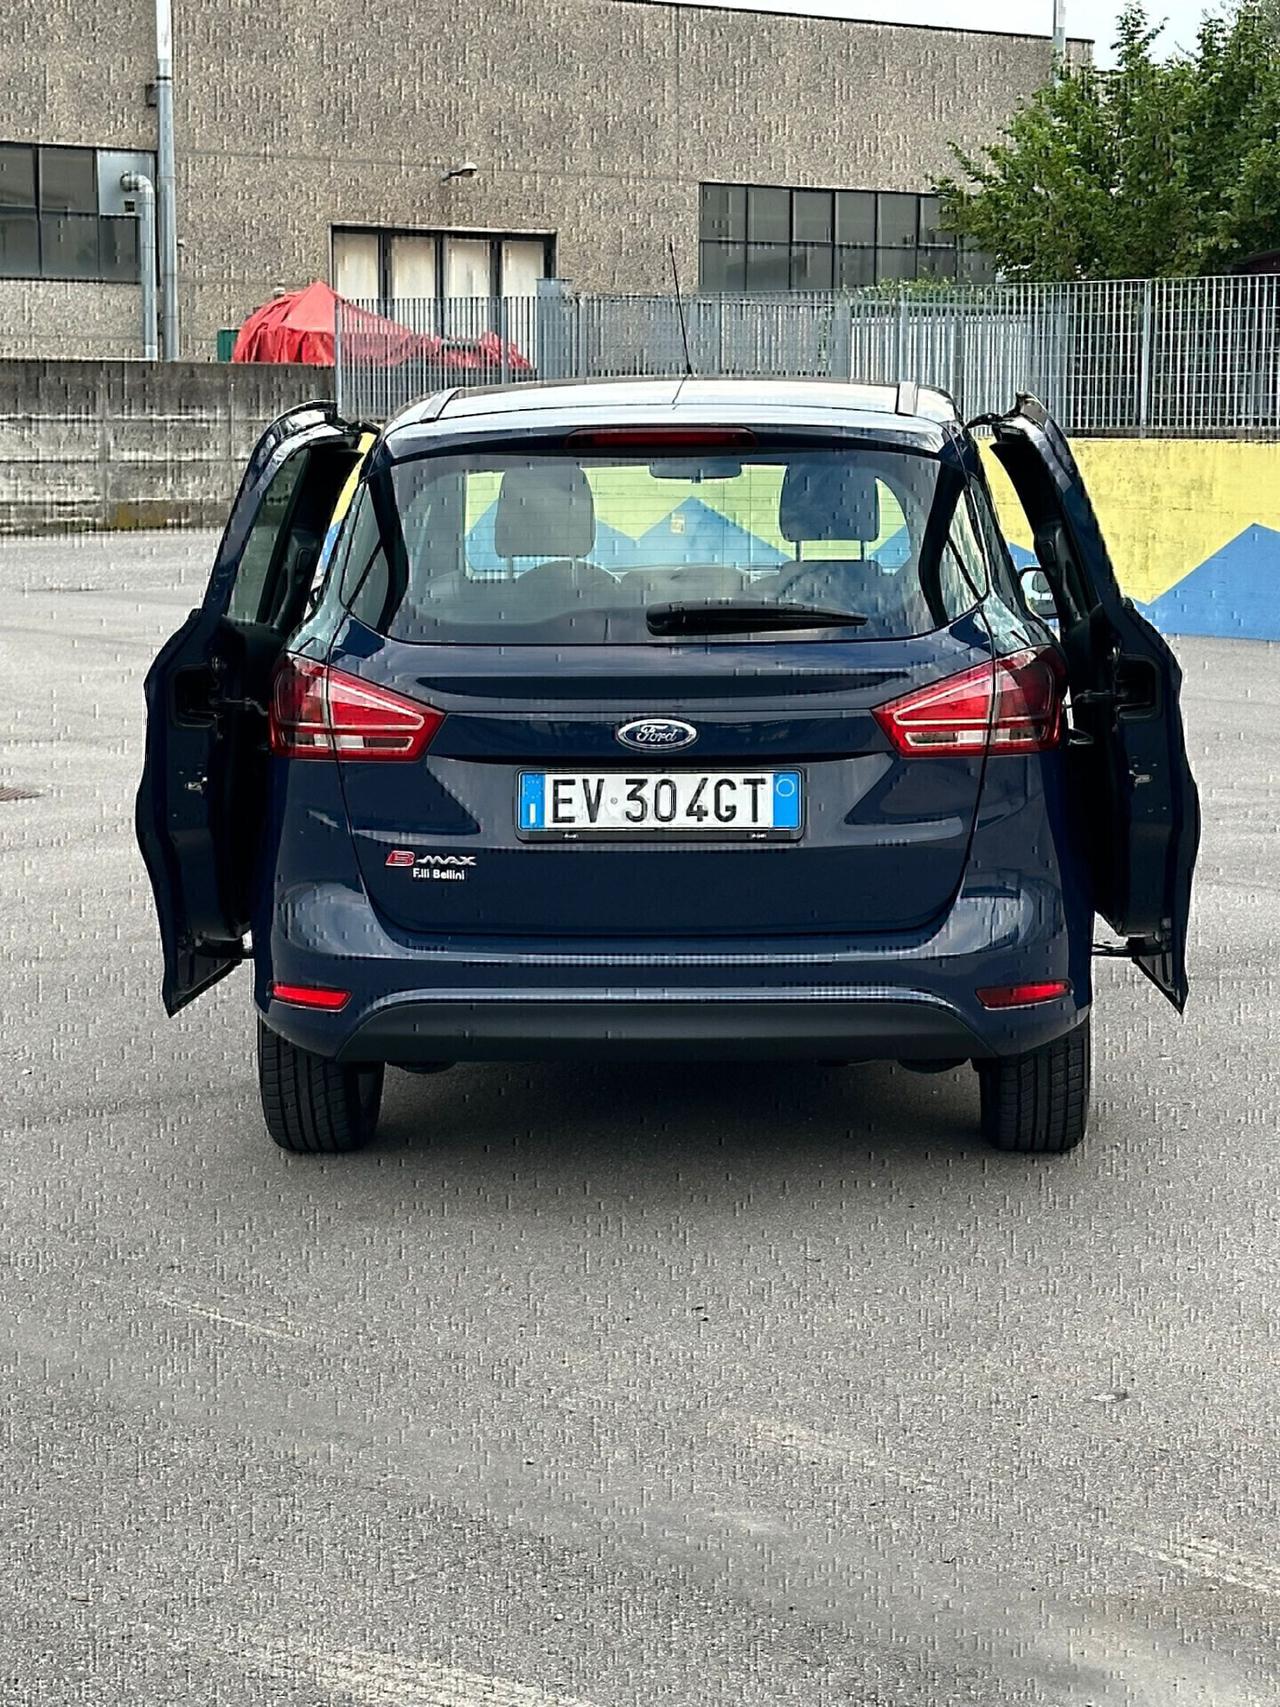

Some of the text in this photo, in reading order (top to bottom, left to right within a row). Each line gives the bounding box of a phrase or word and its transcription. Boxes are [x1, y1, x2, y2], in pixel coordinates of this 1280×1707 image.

[635, 724, 678, 742] Ford
[552, 777, 766, 823] EV 304GT
[432, 868, 465, 880] Bellini
